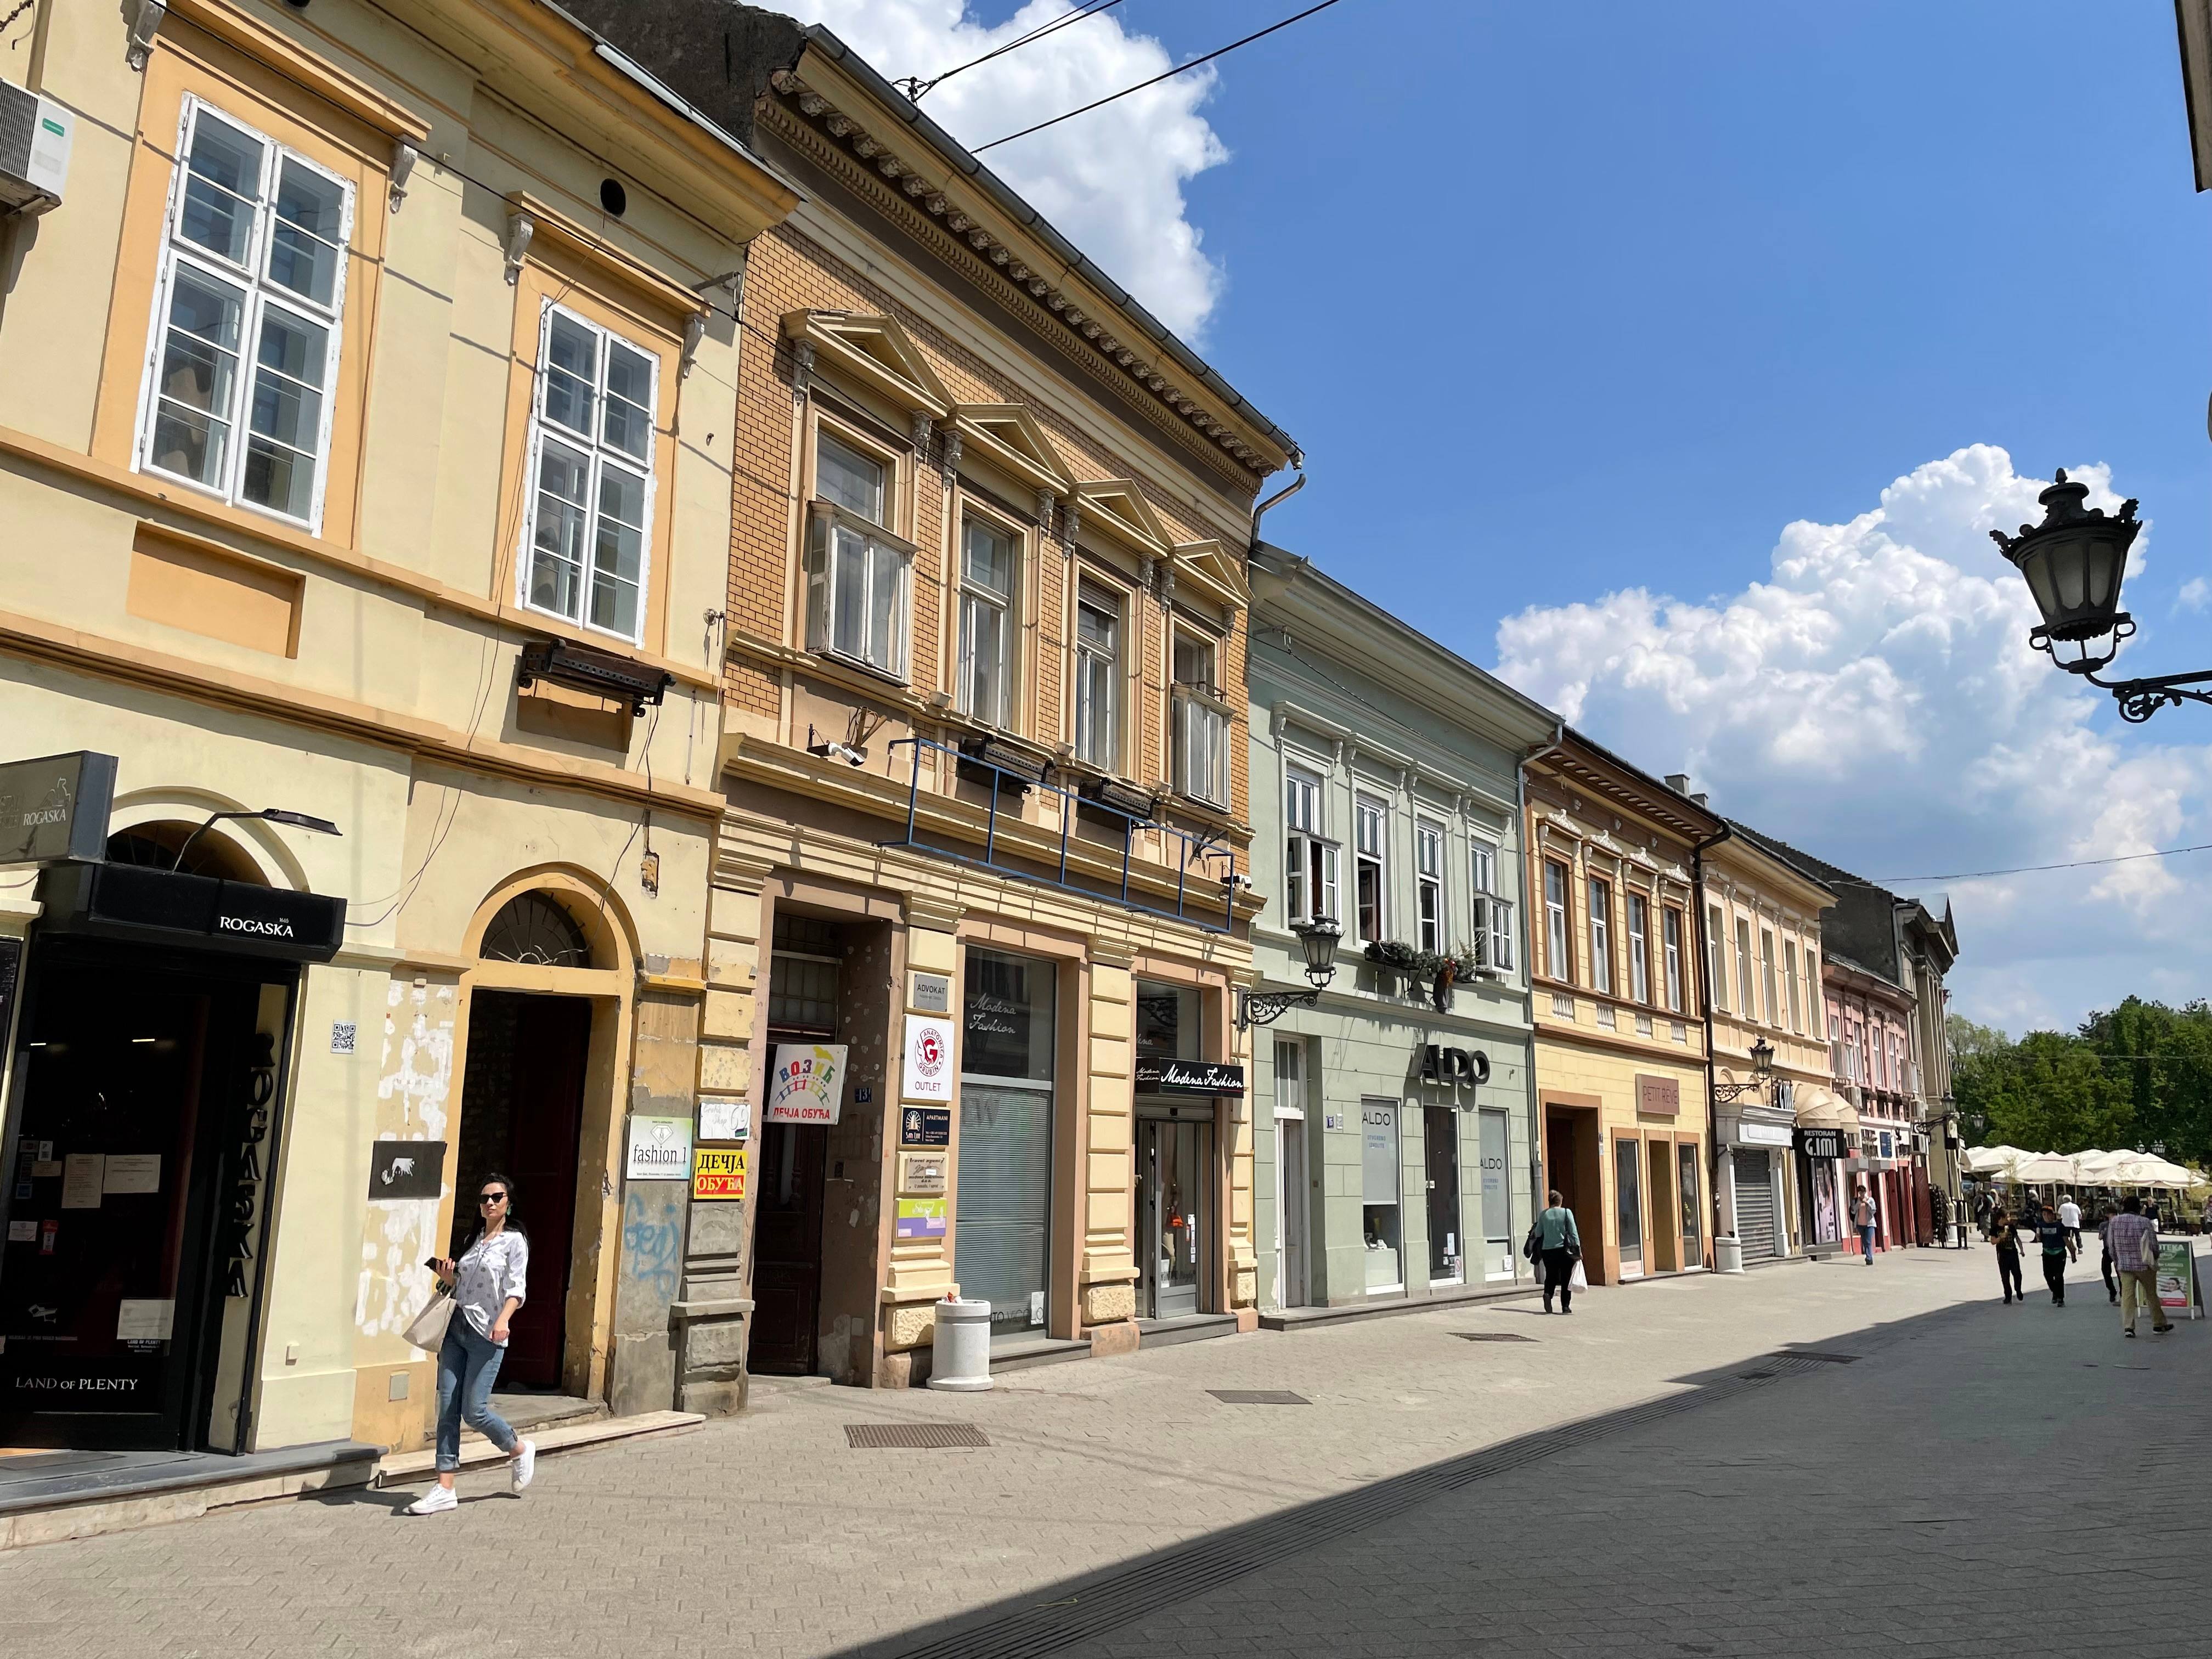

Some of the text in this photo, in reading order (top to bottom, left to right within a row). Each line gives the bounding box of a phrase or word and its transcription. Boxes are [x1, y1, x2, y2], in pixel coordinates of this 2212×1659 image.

[219, 916, 294, 938] ROGASKA
[917, 983, 945, 995] ADVOKAT
[970, 992, 1017, 1015] Modena
[969, 1012, 1016, 1034] Fashion
[918, 1062, 939, 1075] GRUBIN
[1414, 1042, 1491, 1085] ALDO
[1160, 1063, 1243, 1088] Modena Fashion
[915, 1081, 941, 1092] OUTLET
[1643, 1086, 1660, 1102] PETIT
[802, 1108, 830, 1120] ОБУЋА
[1362, 1111, 1391, 1126] ALDO
[634, 1144, 678, 1163] fashion
[697, 1154, 745, 1174] ДЕЧЈА
[1480, 1158, 1503, 1170] ALDO
[697, 1176, 743, 1191] ОБУЋА
[15, 1377, 57, 1389] LAND
[78, 1378, 138, 1391] PLENTY
